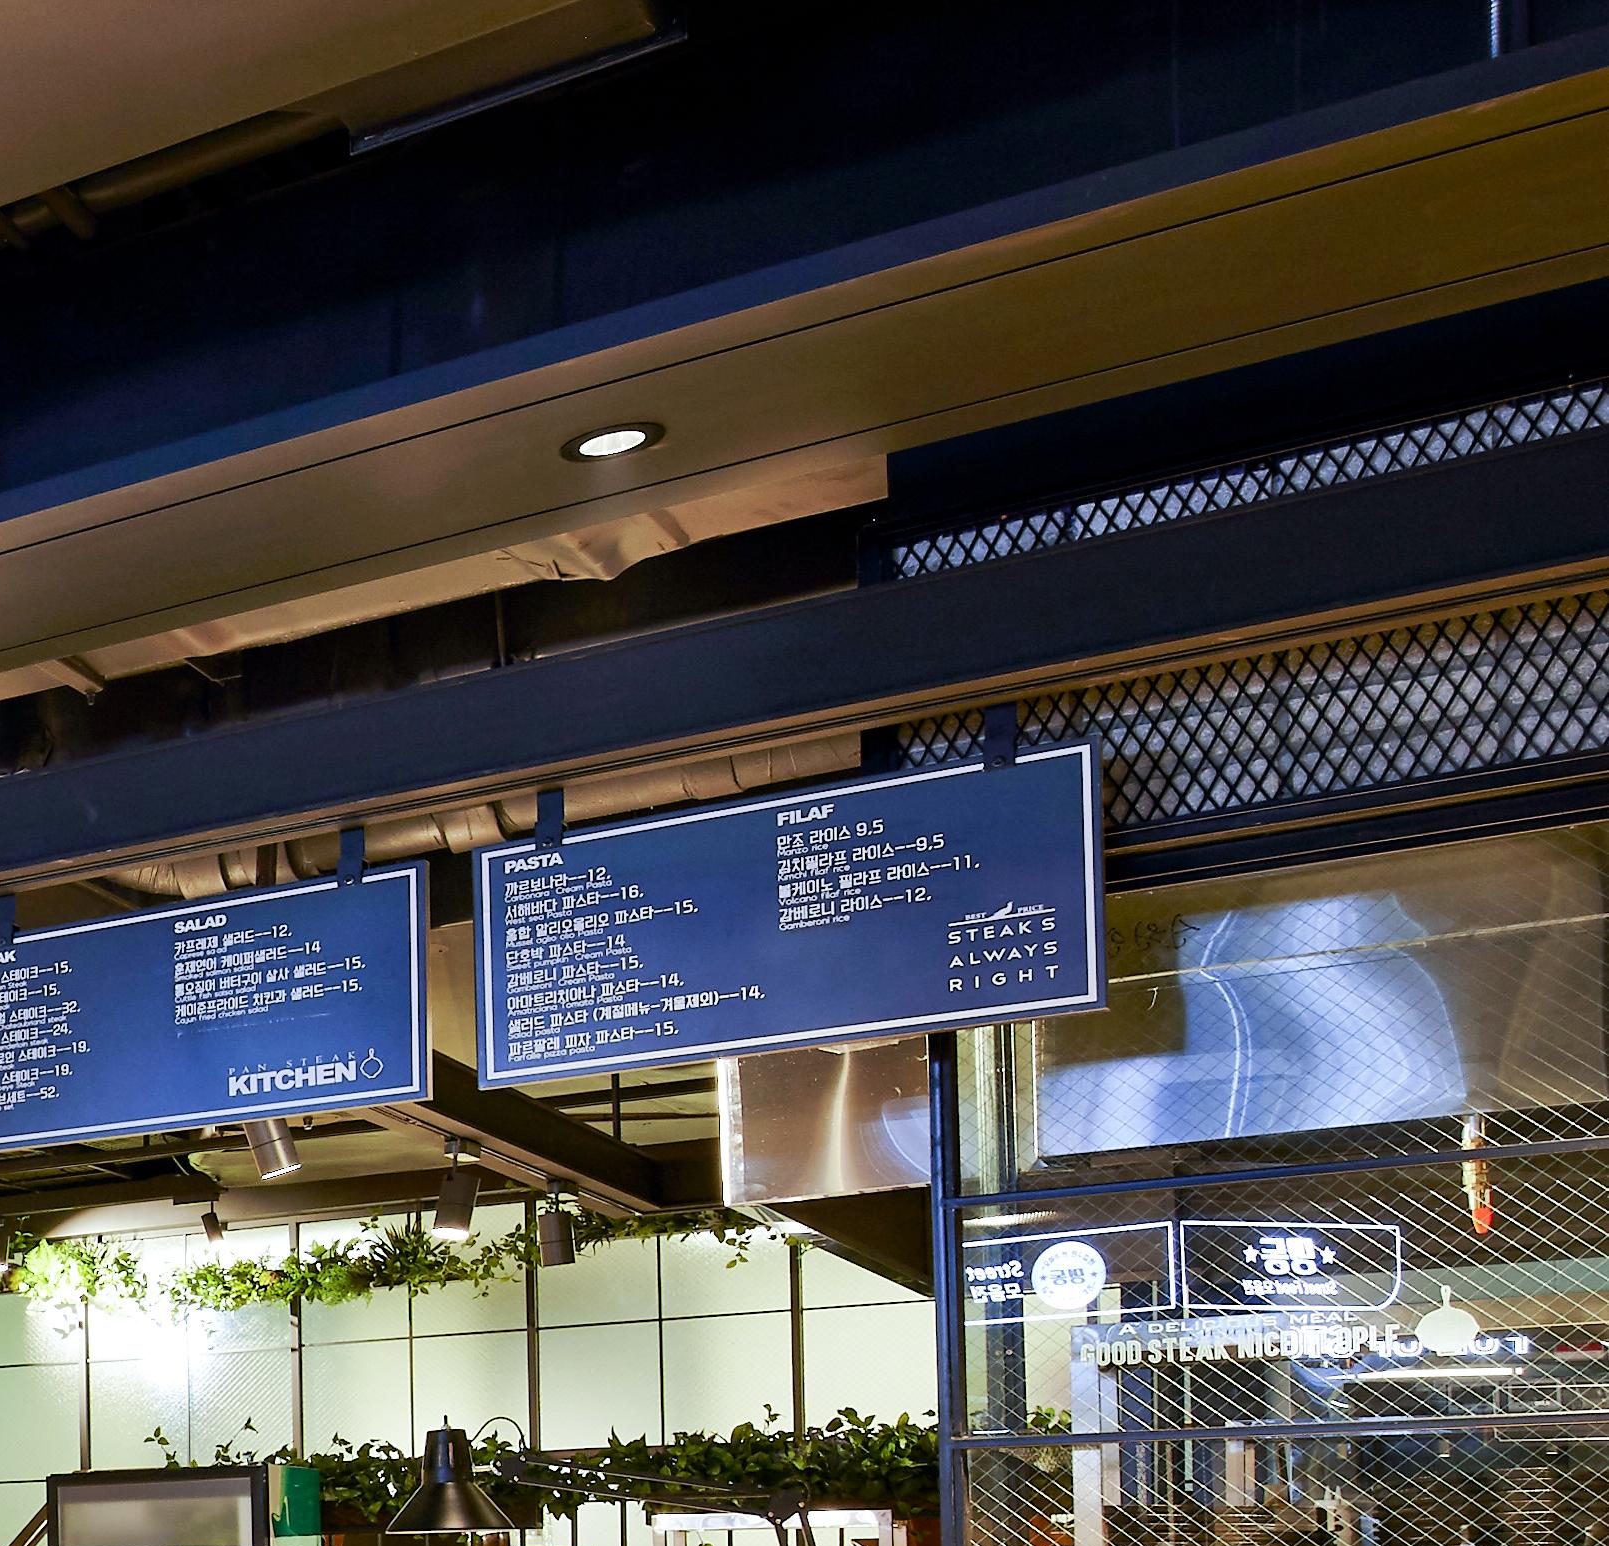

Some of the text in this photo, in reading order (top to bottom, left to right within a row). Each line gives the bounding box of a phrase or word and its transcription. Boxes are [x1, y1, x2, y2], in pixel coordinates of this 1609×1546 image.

[777, 804, 834, 827] FILAF
[810, 825, 851, 844] 라이스
[777, 844, 829, 857] Manzo rice
[504, 852, 563, 874] PASTA
[778, 850, 847, 875] 김치필라프
[833, 864, 851, 873] rice
[839, 868, 881, 889] 필라프
[504, 880, 613, 903] Carbonara Cream Pasta
[778, 895, 818, 906] Volcano
[843, 887, 862, 896] rice
[506, 898, 557, 919] 서해바다
[529, 913, 544, 922] sea
[547, 910, 572, 919] Pasta
[779, 900, 835, 923] 감베로니
[965, 904, 1044, 920] BEST PRICE
[174, 914, 227, 934] SALAD
[578, 928, 603, 937] Pasta
[779, 914, 850, 931] Gamberoni rice
[948, 917, 1056, 945] STEAKS
[174, 936, 218, 955] 카프레제
[506, 947, 544, 965] 단호박
[949, 941, 1058, 968] ALWAYS
[534, 957, 569, 968] pumpkin
[575, 951, 603, 960] Cream
[606, 946, 632, 956] Pasta
[219, 971, 262, 989] 버터구이
[266, 967, 289, 983] 살사
[507, 967, 556, 988] 감베로니
[507, 973, 615, 994] Gamberoni Cream Pasta
[949, 965, 1059, 992] RIGHT
[175, 995, 249, 1018] 케이준프라이드
[507, 985, 597, 1011] 아마트리치아나
[561, 1000, 594, 1009] Tomato
[597, 995, 623, 1004] Pasta
[174, 1005, 269, 1025] Cajun fried chicken salad
[508, 1016, 545, 1034] 샐러드
[550, 1009, 589, 1028] 파스타
[508, 1027, 561, 1040] Salad pasta
[565, 1032, 591, 1049] 피자
[228, 1051, 357, 1075] PAN STEAK
[544, 1049, 567, 1060] pizza
[569, 1045, 595, 1055] pasta
[228, 1060, 357, 1097] KITCHEN
[1290, 1311, 1359, 1325] MEAL
[1080, 1341, 1142, 1367] GOOD
[1147, 1335, 1231, 1364] STEAK
